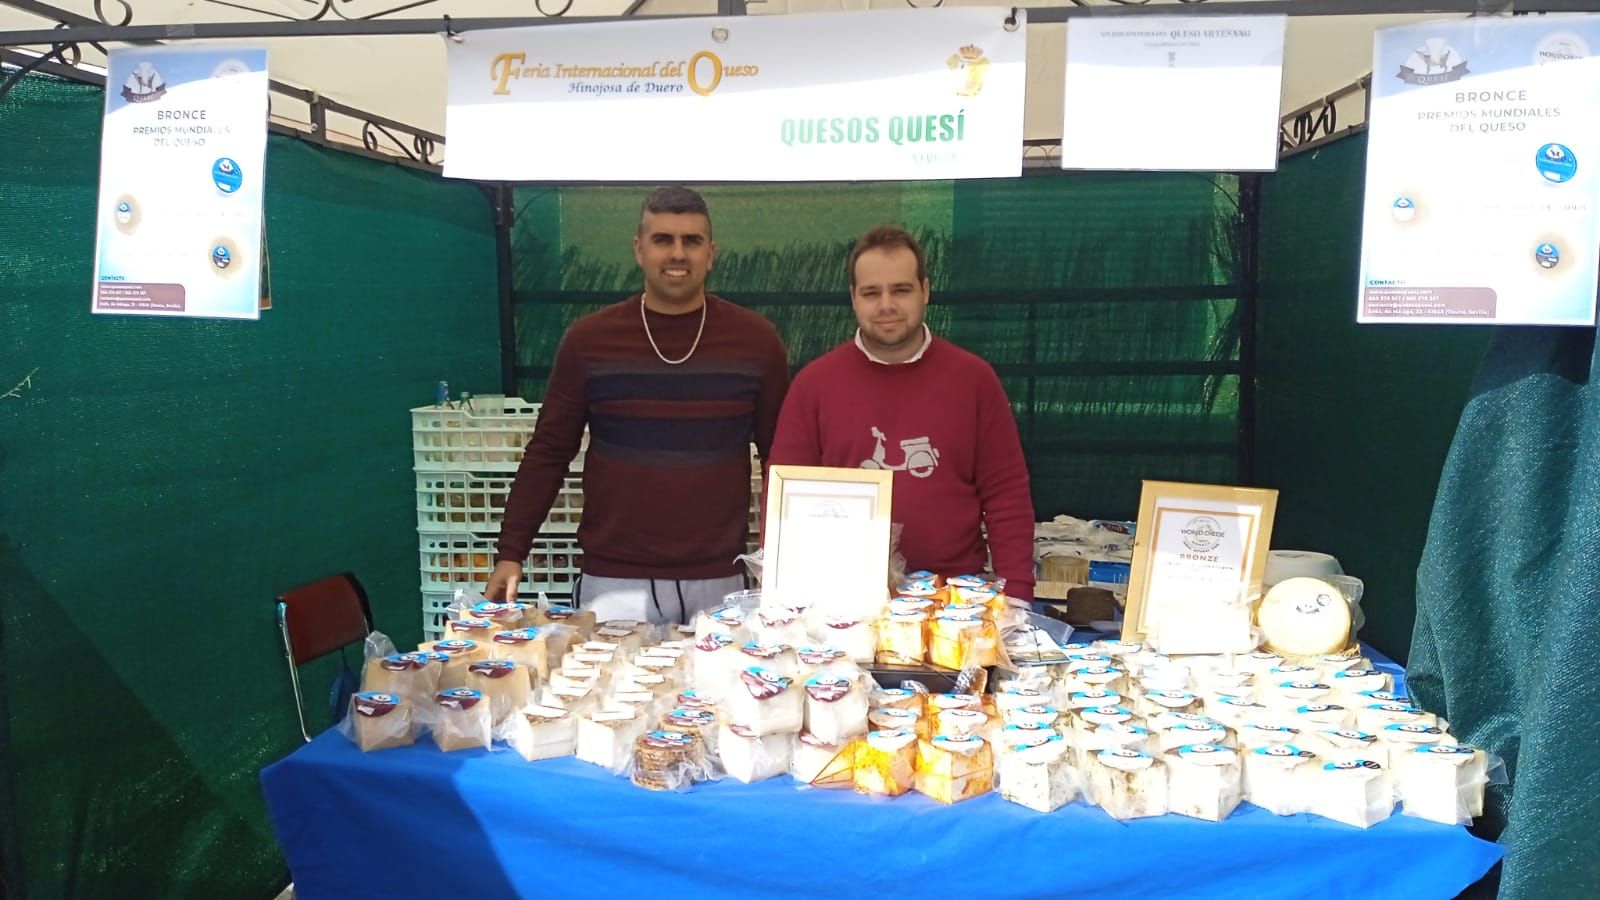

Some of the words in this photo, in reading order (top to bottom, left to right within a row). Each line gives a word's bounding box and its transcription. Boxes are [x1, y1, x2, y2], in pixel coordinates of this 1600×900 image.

[490, 52, 550, 96] Feria
[552, 60, 657, 78] Internacional
[658, 60, 686, 78] del
[687, 50, 759, 97] Queso
[568, 81, 626, 94] Hinojosa
[627, 81, 641, 93] de
[644, 82, 683, 93] Duero
[1455, 90, 1528, 104] BRONCE
[157, 109, 207, 120] BRONCE
[1417, 110, 1477, 121] PREMIOS
[1481, 107, 1561, 118] MUNDIALES
[133, 126, 172, 135] PREMIOS
[781, 116, 880, 147] QUESOS
[888, 108, 965, 145] QUESÍ
[1449, 123, 1474, 133] DEL
[1479, 121, 1526, 133] QUESO
[154, 138, 170, 146] DEL
[172, 137, 206, 148] QUESO
[1179, 553, 1219, 563] BRONZE
